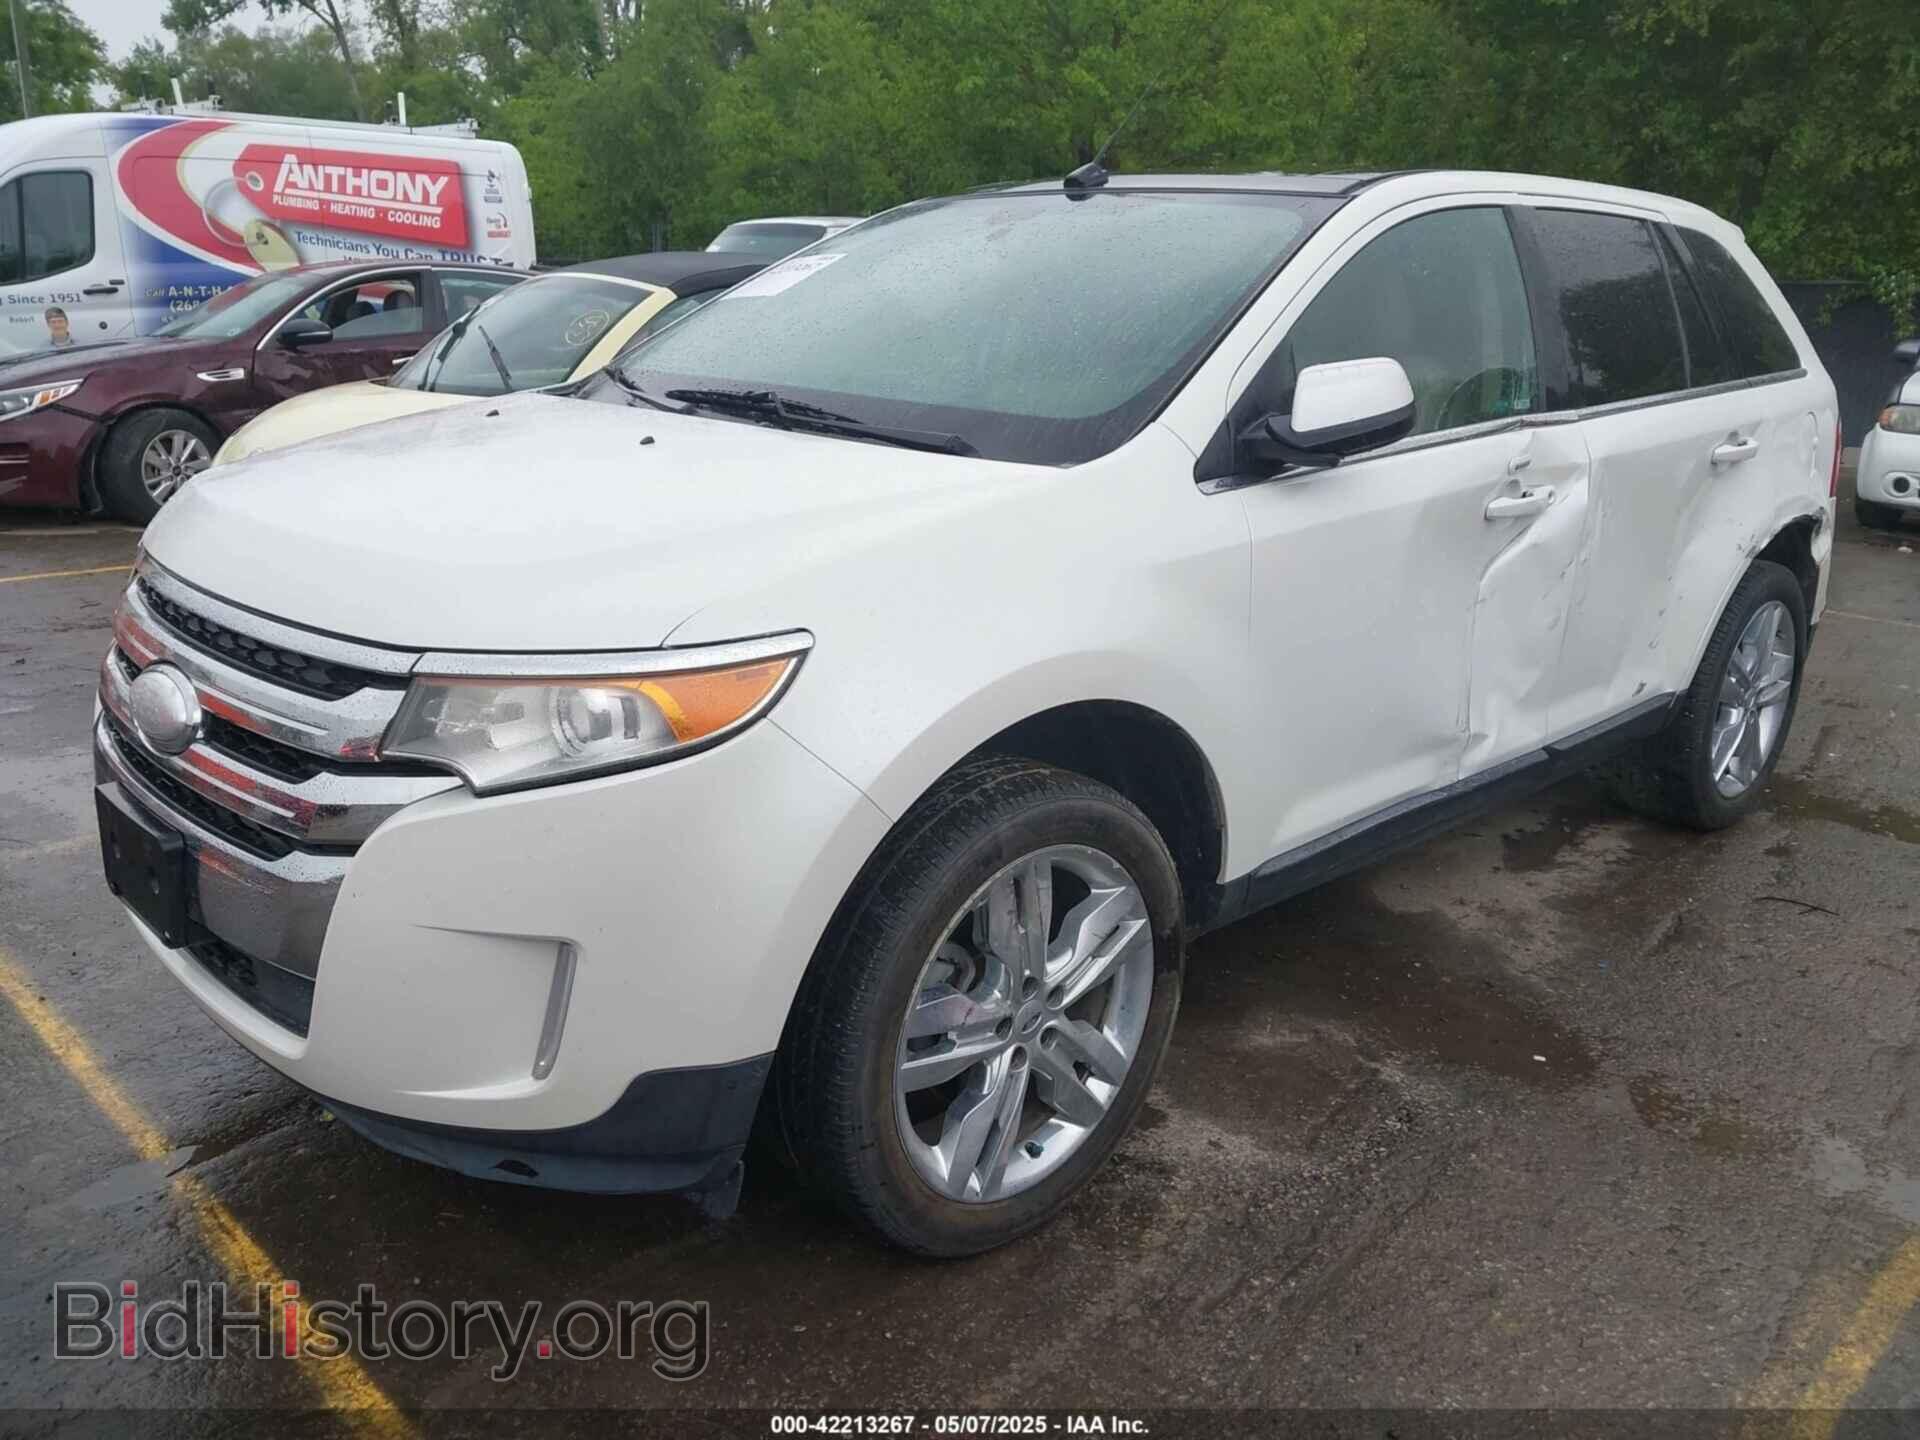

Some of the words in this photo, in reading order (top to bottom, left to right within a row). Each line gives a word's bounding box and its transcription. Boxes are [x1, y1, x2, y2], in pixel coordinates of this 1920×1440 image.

[273, 153, 448, 205] ANTHONY
[273, 194, 319, 210] PLUMBING
[330, 202, 375, 219] HEATING
[388, 210, 441, 229] COOLING
[295, 231, 371, 255] Technicians
[372, 242, 400, 259] You
[404, 247, 433, 261] Can
[7, 294, 45, 305] Since
[49, 292, 81, 304] 1951
